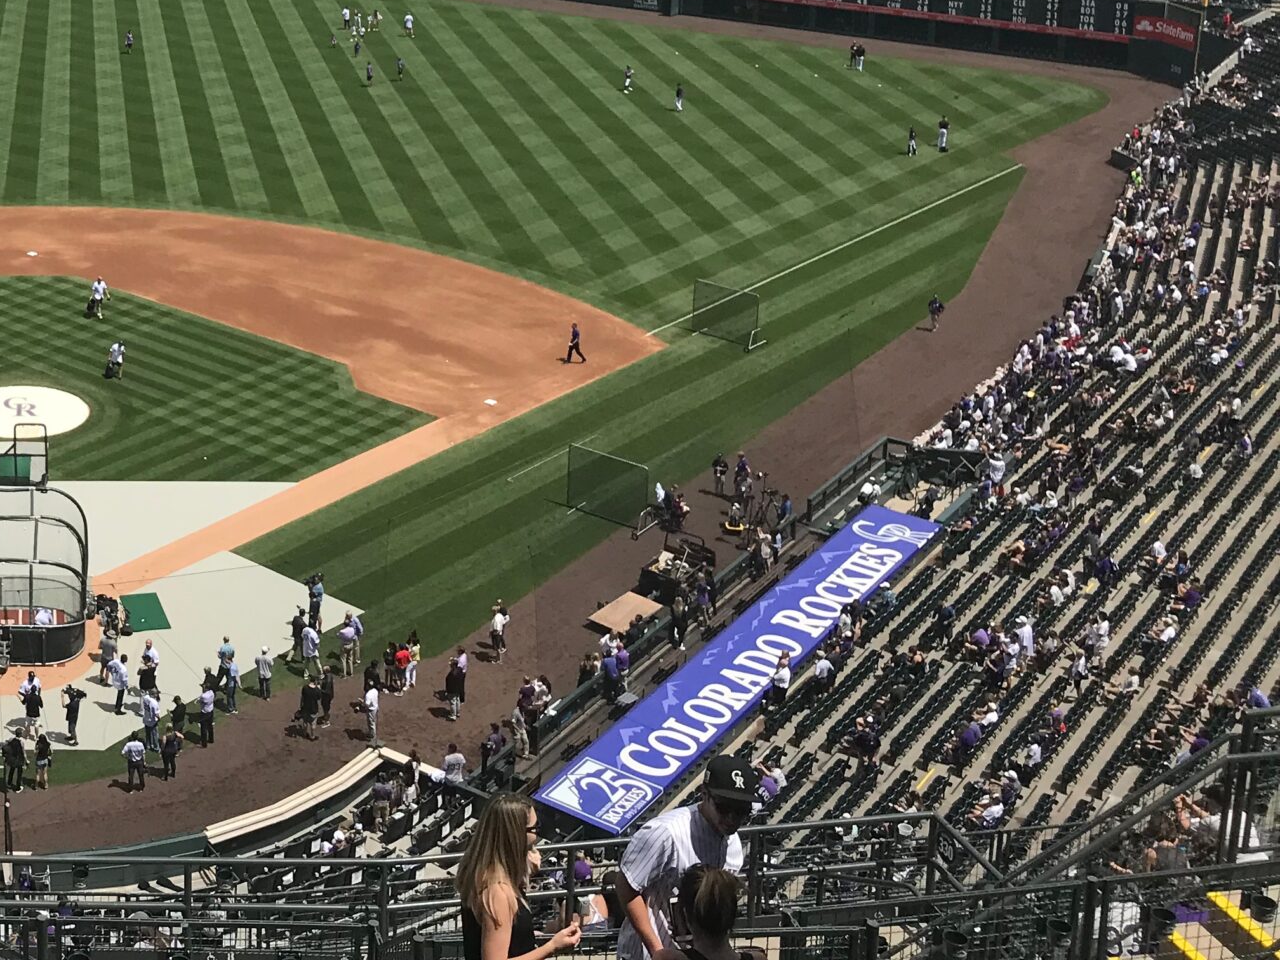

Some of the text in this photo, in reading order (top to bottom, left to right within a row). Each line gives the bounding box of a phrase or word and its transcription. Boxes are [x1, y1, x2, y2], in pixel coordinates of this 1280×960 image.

[1155, 22, 1194, 41] StateFarm
[3, 397, 37, 416] CR
[851, 519, 939, 549] CR
[770, 542, 903, 637] ROCKIES
[619, 634, 803, 777] COLORADO
[580, 769, 652, 803] 25
[731, 770, 745, 789] CR
[601, 787, 646, 824] ROCKIES
